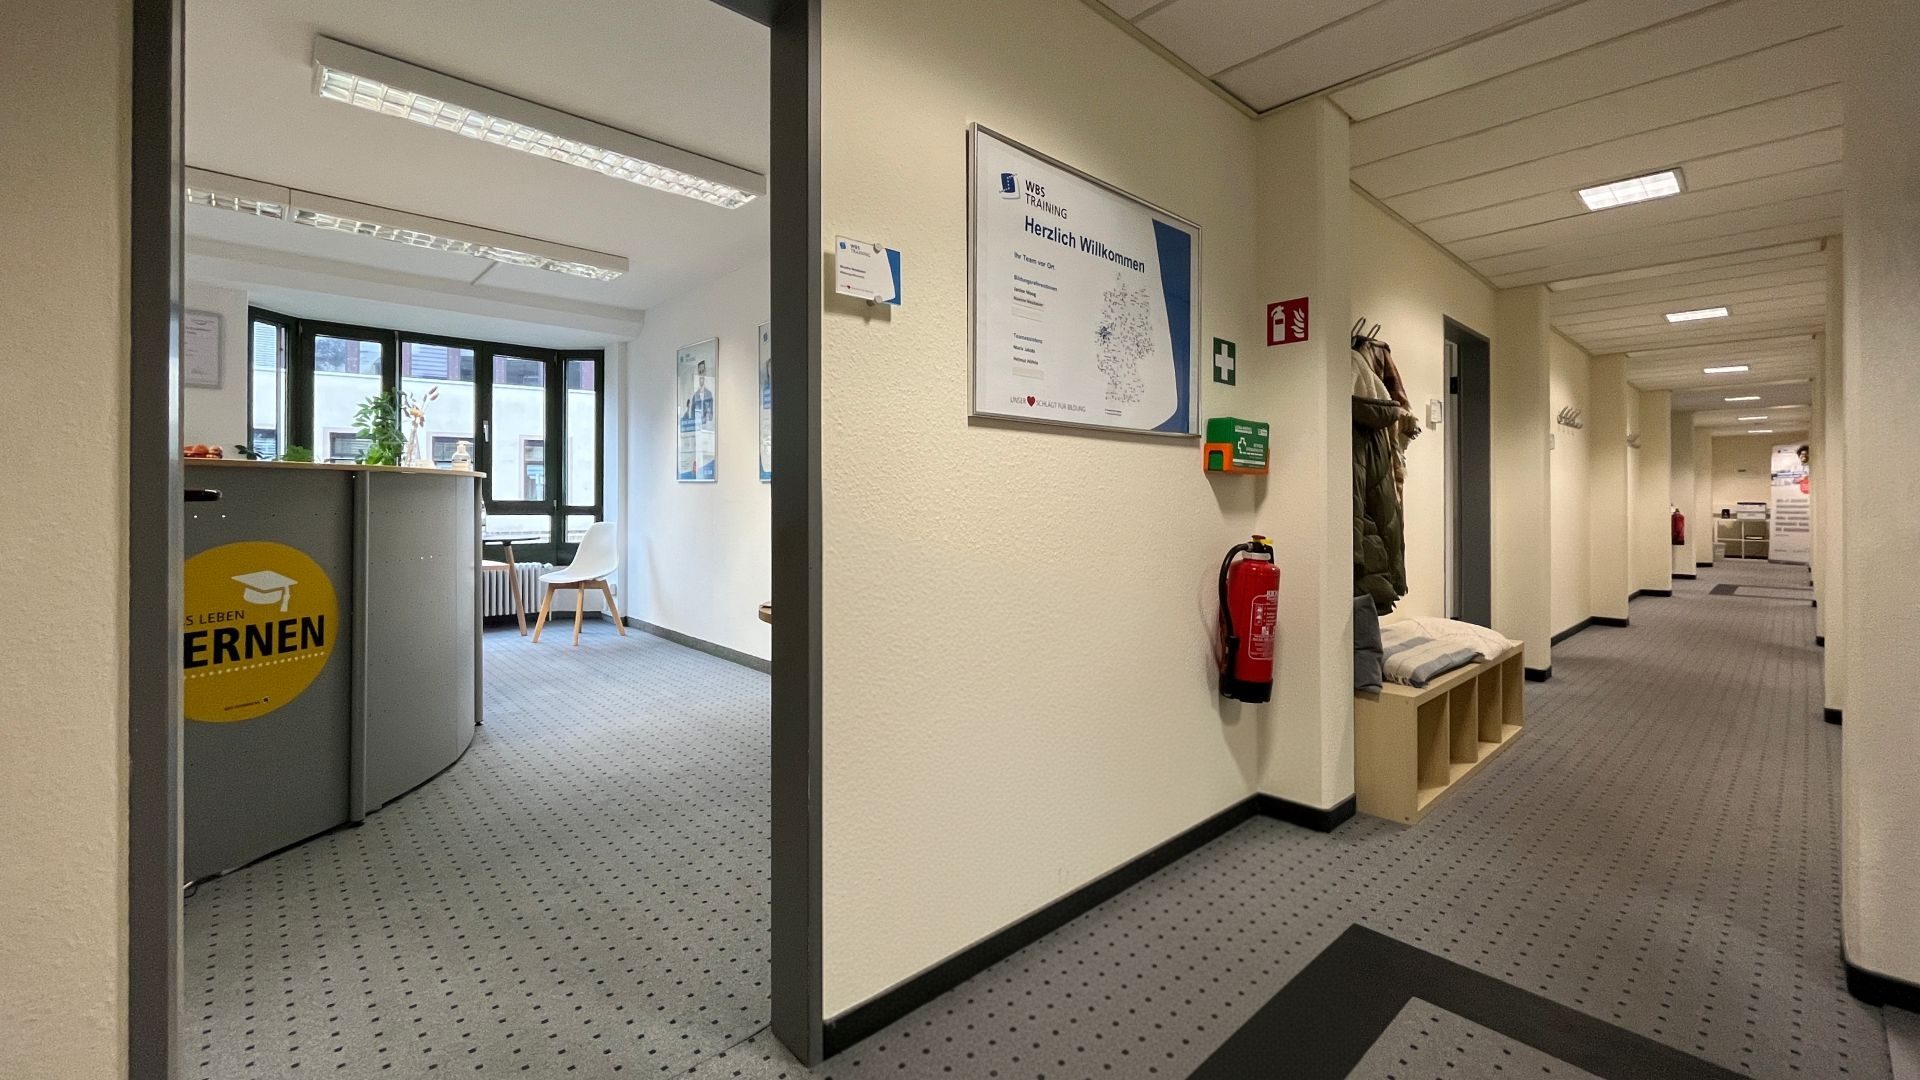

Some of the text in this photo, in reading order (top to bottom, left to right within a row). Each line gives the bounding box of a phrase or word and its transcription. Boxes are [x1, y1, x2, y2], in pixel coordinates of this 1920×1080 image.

[1025, 180, 1046, 198] WBS
[1025, 193, 1068, 220] TRAINING
[1025, 215, 1145, 274] Herzlich Willkommen
[1022, 254, 1037, 265] Team
[199, 610, 245, 625] LEBEN
[184, 614, 325, 669] ERNEN
